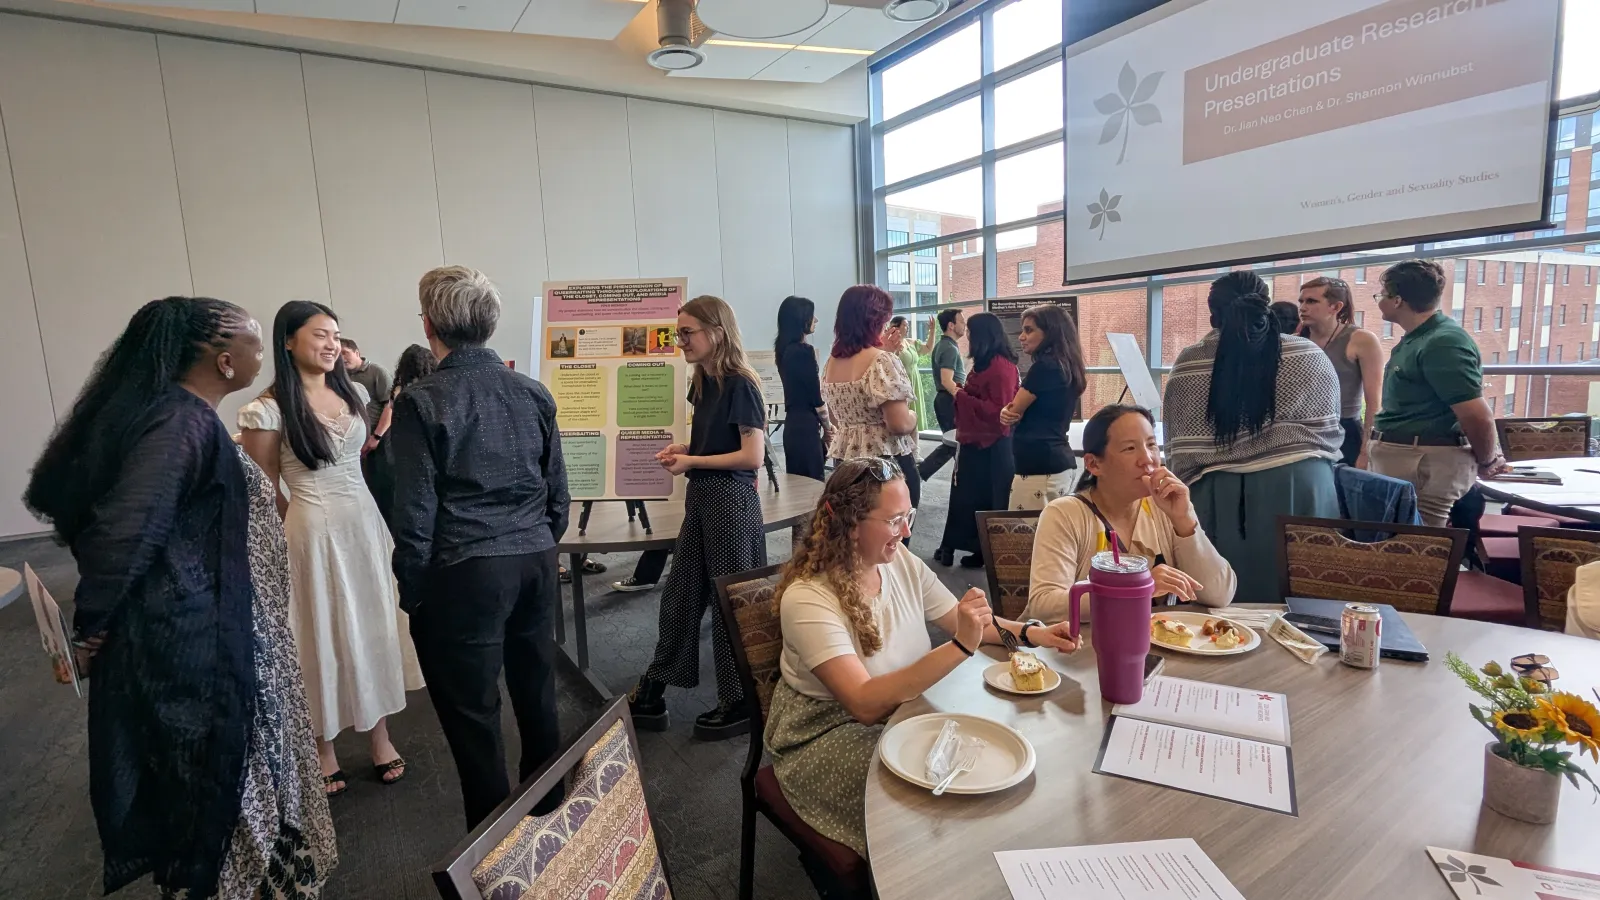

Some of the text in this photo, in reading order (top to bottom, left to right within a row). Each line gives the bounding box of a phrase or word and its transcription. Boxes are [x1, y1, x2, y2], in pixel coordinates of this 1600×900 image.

[1205, 34, 1354, 92] Undergraduate
[1204, 66, 1342, 118] Presentations
[1224, 61, 1475, 135] Dr. Jian Neo Chen & Dr. Shannon Winnubst
[1300, 170, 1500, 210] Women's, Gender and Sexuality Studies
